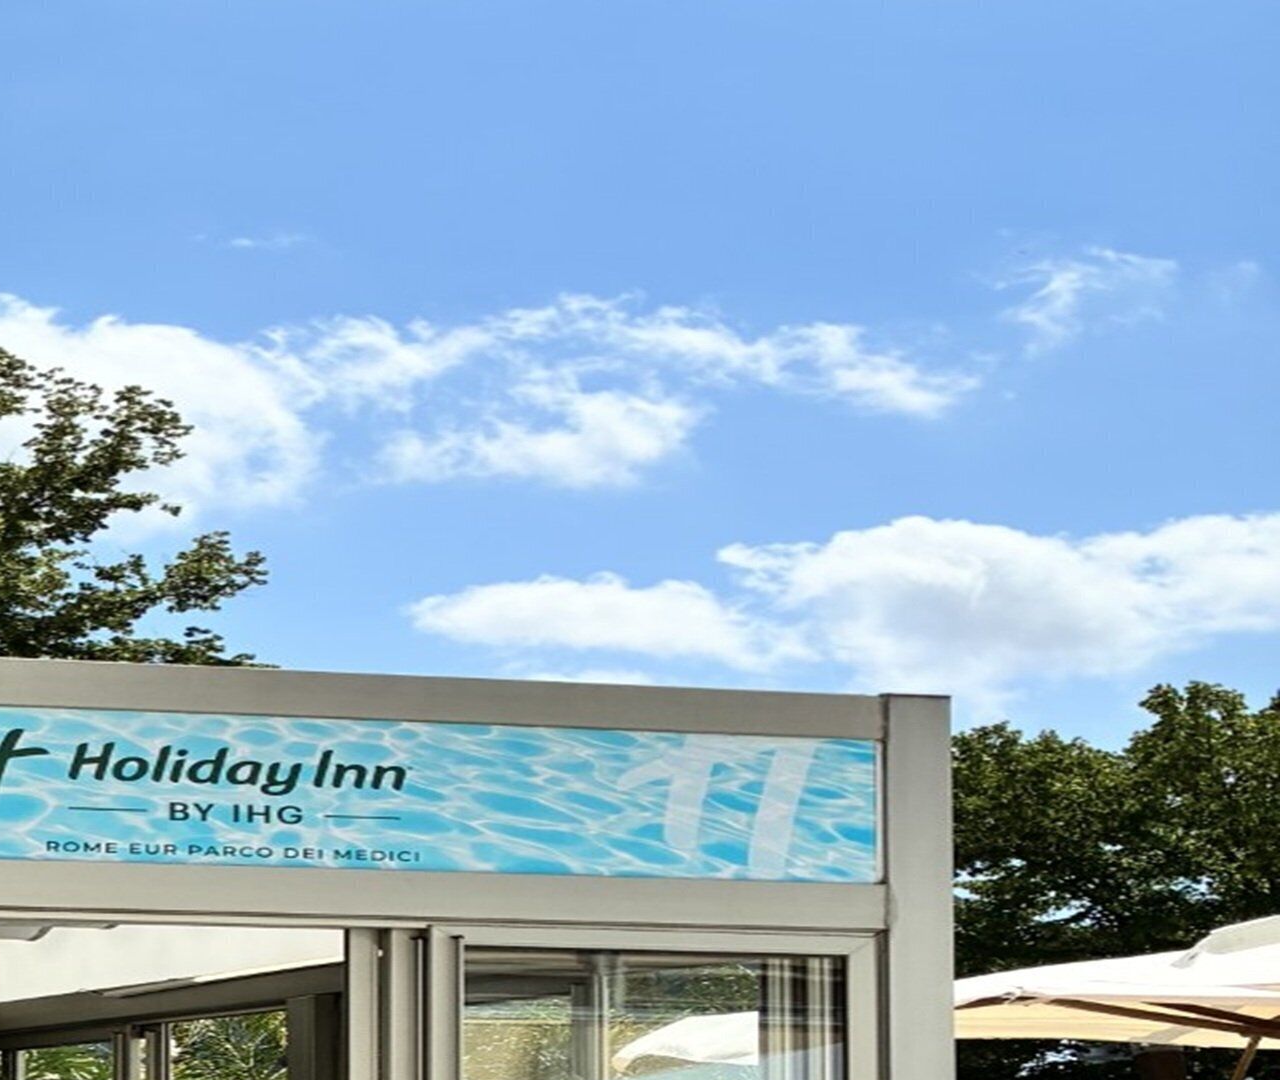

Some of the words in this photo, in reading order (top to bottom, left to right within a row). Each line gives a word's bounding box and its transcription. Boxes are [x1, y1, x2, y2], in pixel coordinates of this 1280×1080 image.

[67, 741, 302, 796] Holiday
[313, 749, 408, 791] Inn
[167, 801, 215, 822] BY
[232, 804, 305, 825] IHG
[45, 840, 119, 855] ROME
[127, 842, 178, 857] EUR
[187, 844, 274, 859] PARCO
[283, 846, 324, 861] DEI
[332, 848, 421, 863] MEDICI
